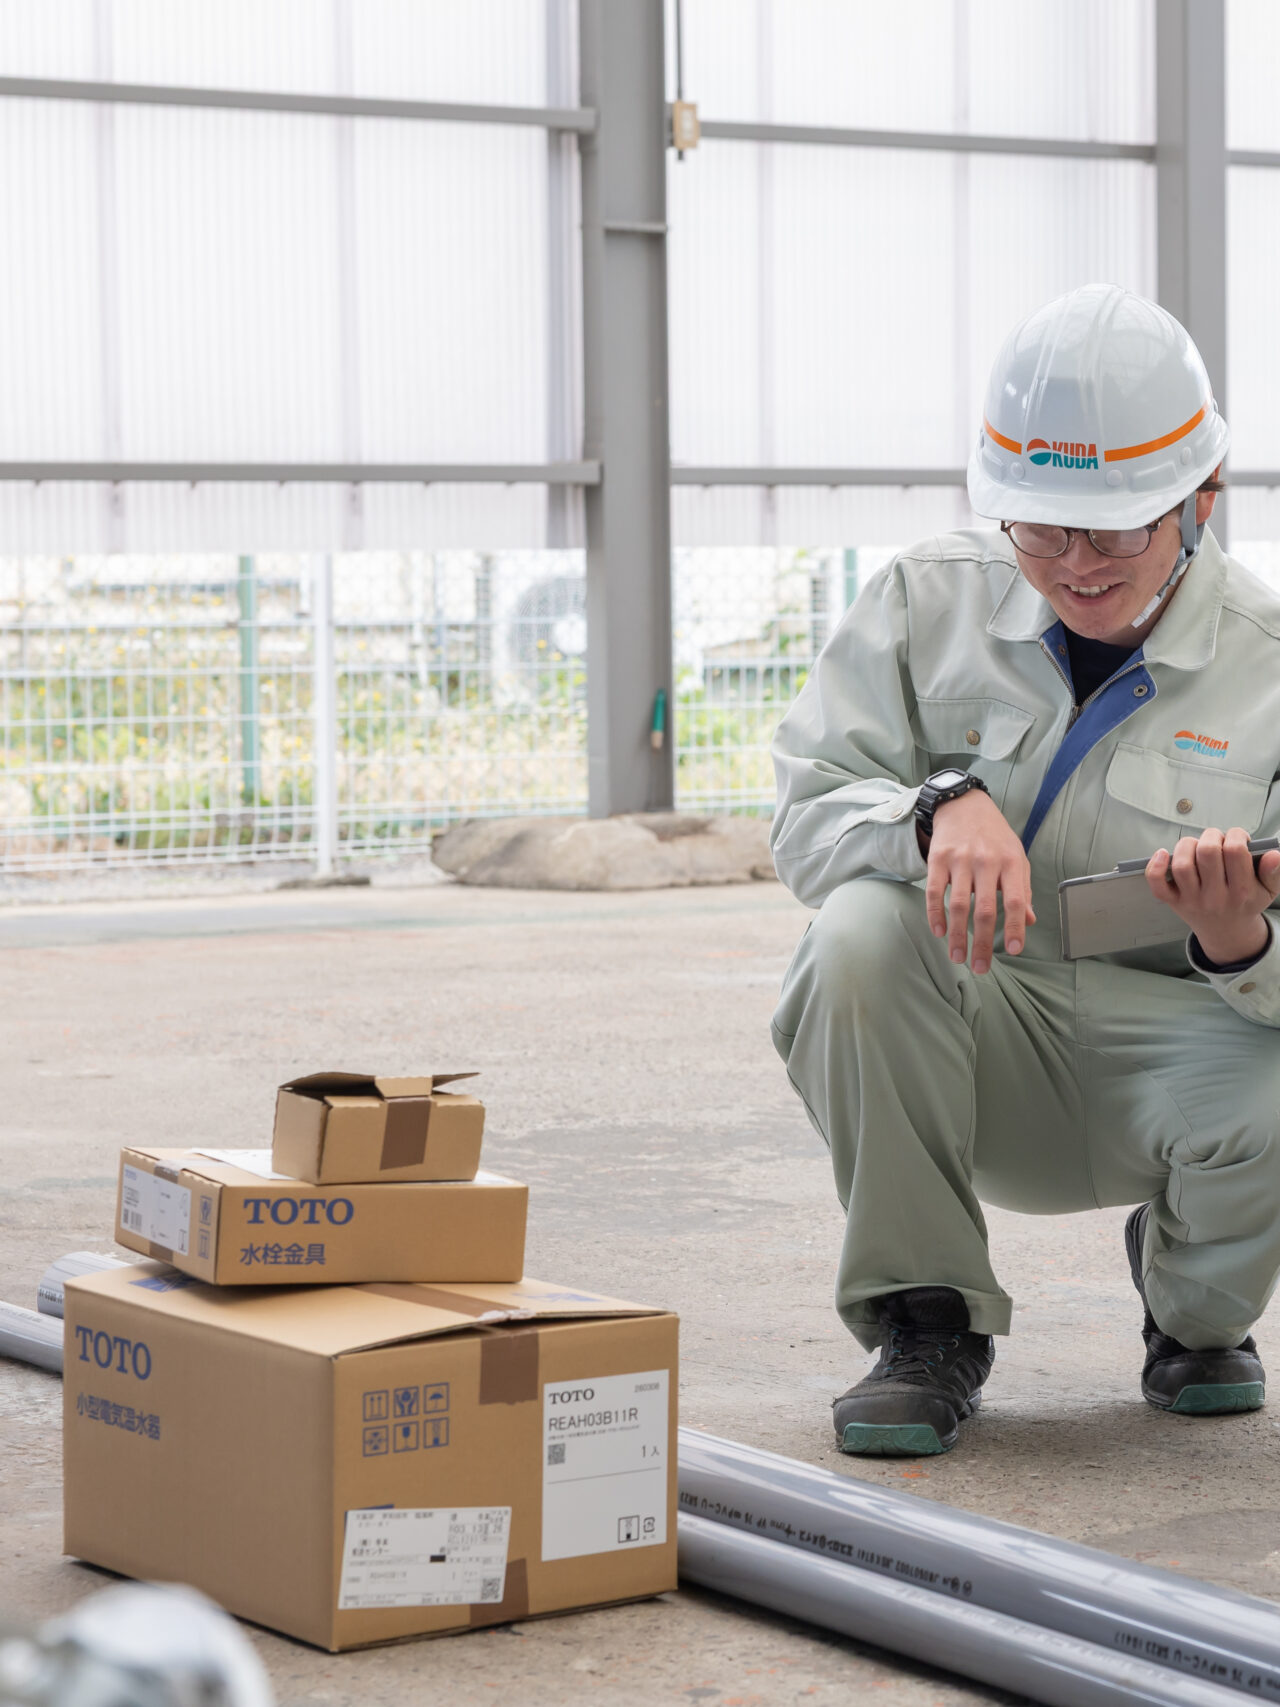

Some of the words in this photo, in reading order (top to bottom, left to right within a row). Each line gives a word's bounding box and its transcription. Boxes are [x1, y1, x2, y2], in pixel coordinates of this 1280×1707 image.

[243, 1197, 354, 1226] TOTO
[239, 1243, 327, 1266] 水栓金具
[75, 1325, 152, 1381] TOTO
[548, 1388, 595, 1405] TOTO
[548, 1407, 639, 1432] REAH03B11R
